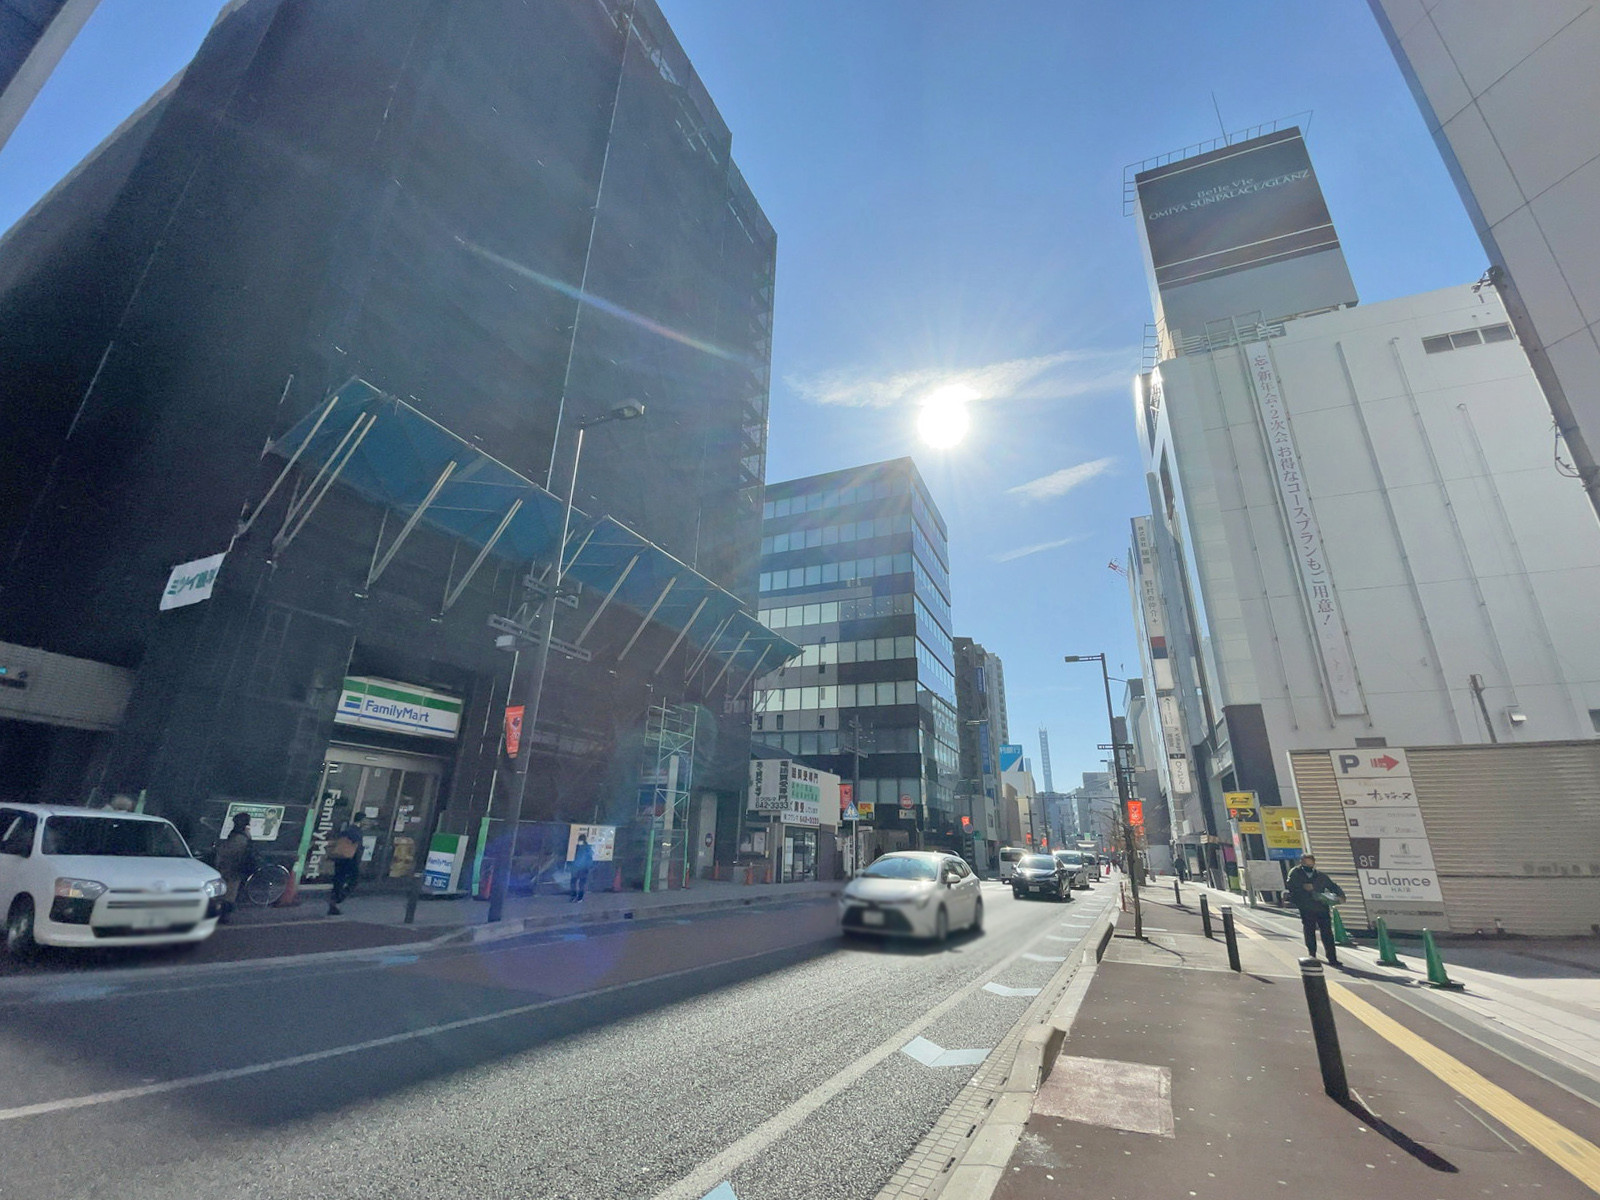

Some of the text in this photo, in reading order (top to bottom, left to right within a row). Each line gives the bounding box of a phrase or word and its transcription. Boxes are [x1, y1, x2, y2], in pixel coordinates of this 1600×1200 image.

[1148, 168, 1310, 220] OMIYA SUNPALACE/GLANZ
[364, 699, 430, 723] FamilyMart
[1338, 754, 1360, 774] P
[755, 801, 789, 809] 642-3333
[305, 788, 342, 880] FamilyMart
[1359, 855, 1376, 868] 8F
[1366, 870, 1431, 887] balance
